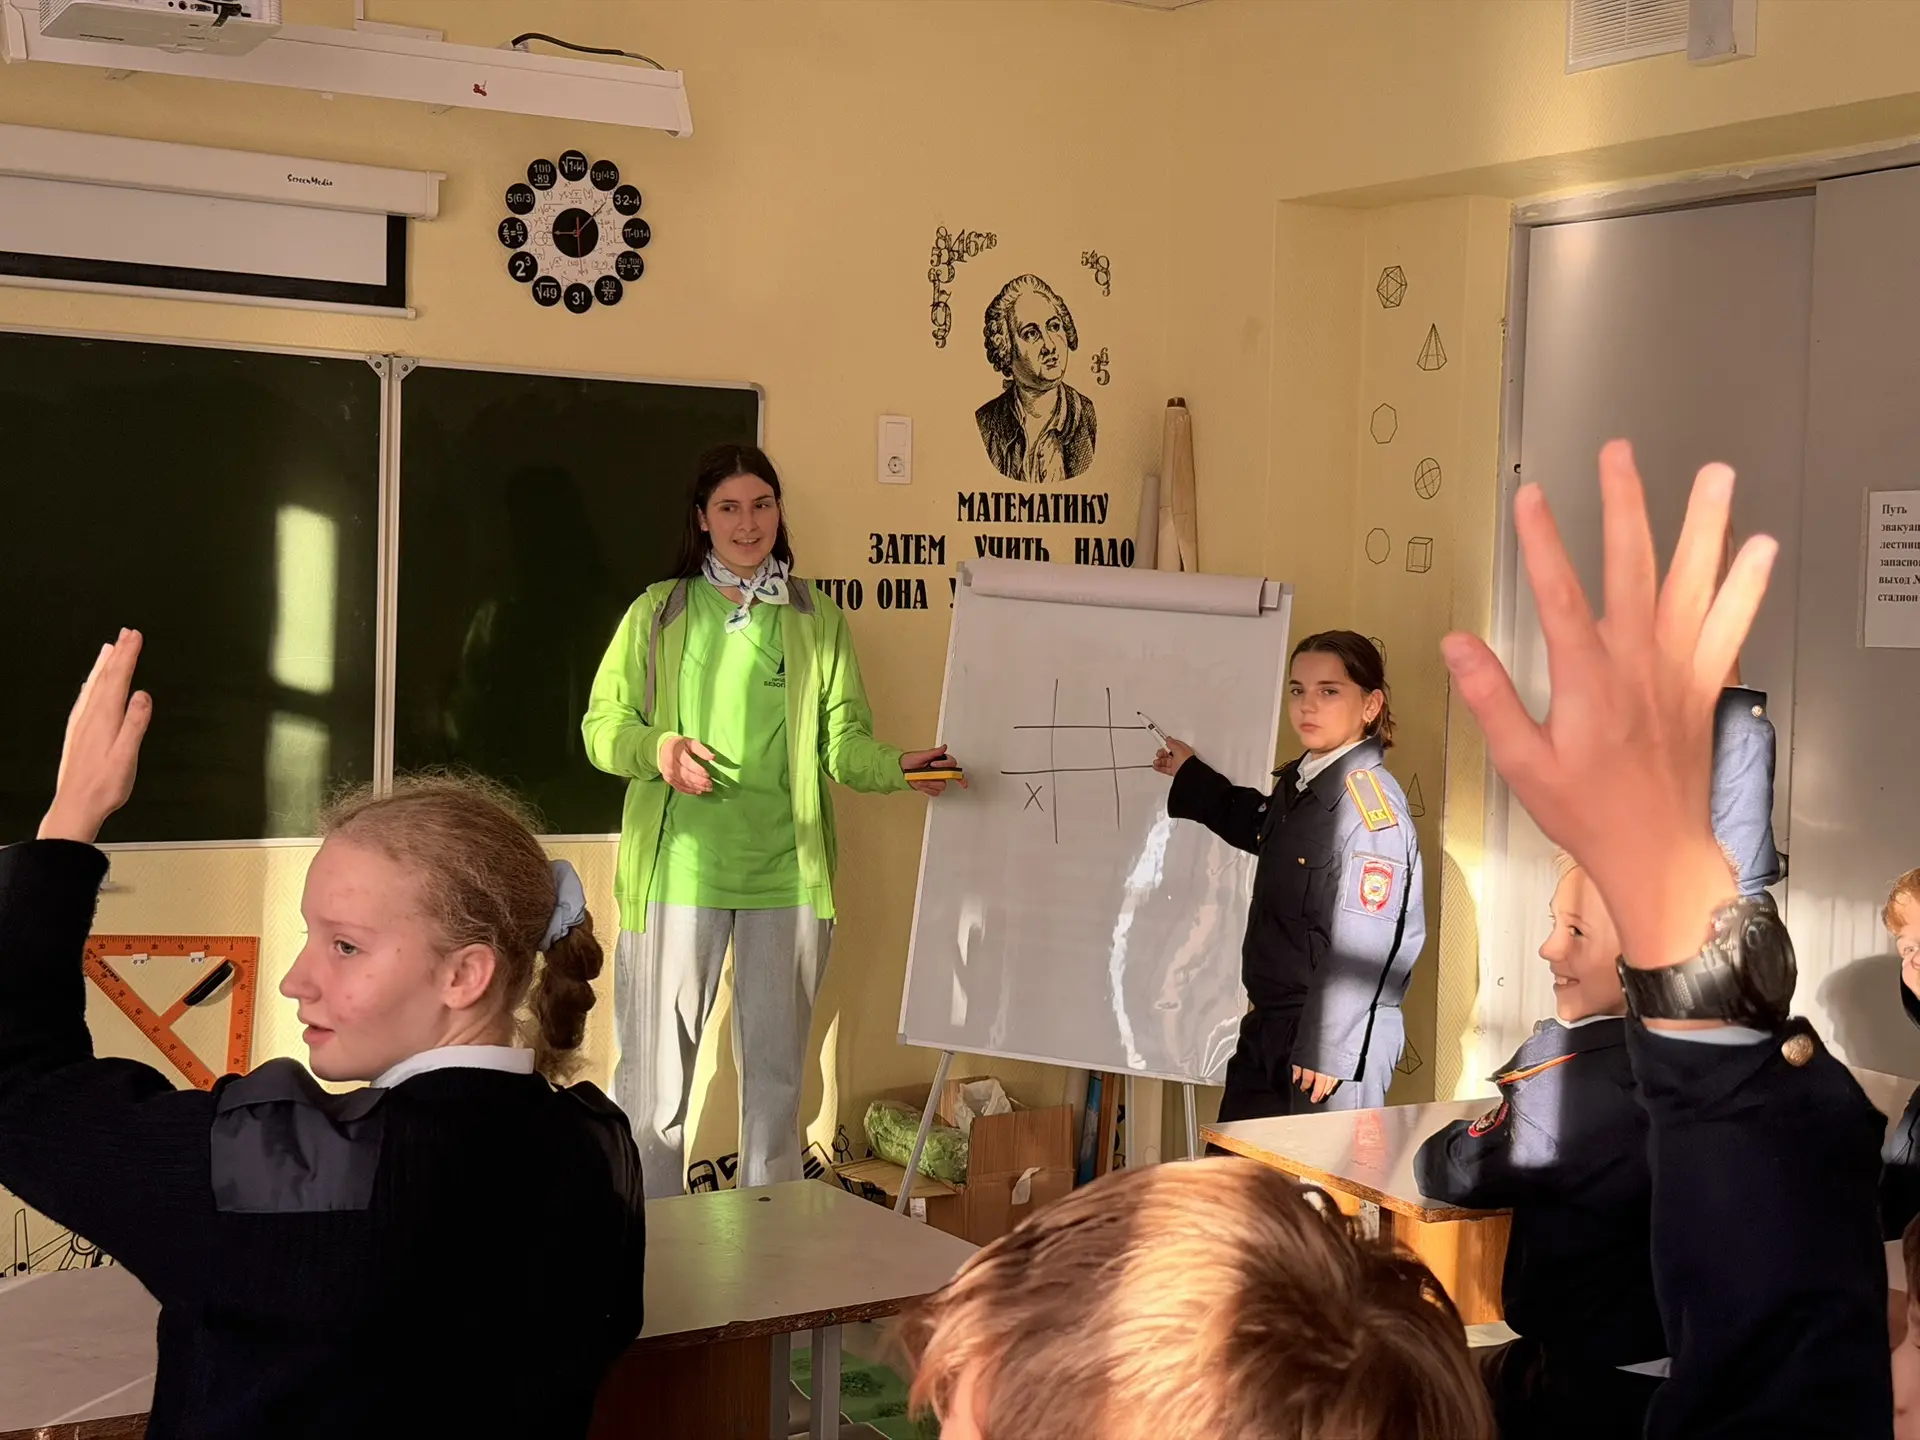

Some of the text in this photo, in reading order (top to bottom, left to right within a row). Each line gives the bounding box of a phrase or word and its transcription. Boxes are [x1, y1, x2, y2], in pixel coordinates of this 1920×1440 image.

[957, 491, 1109, 524] МАТЕМАТИКУ
[1882, 504, 1907, 516] Путь
[868, 533, 946, 565] ЗАТЕМ
[1074, 538, 1135, 568] НАДО
[1880, 559, 1920, 567] запасно
[1879, 575, 1910, 585] выход
[877, 578, 928, 609] ОНА
[1877, 593, 1918, 602] стадион
